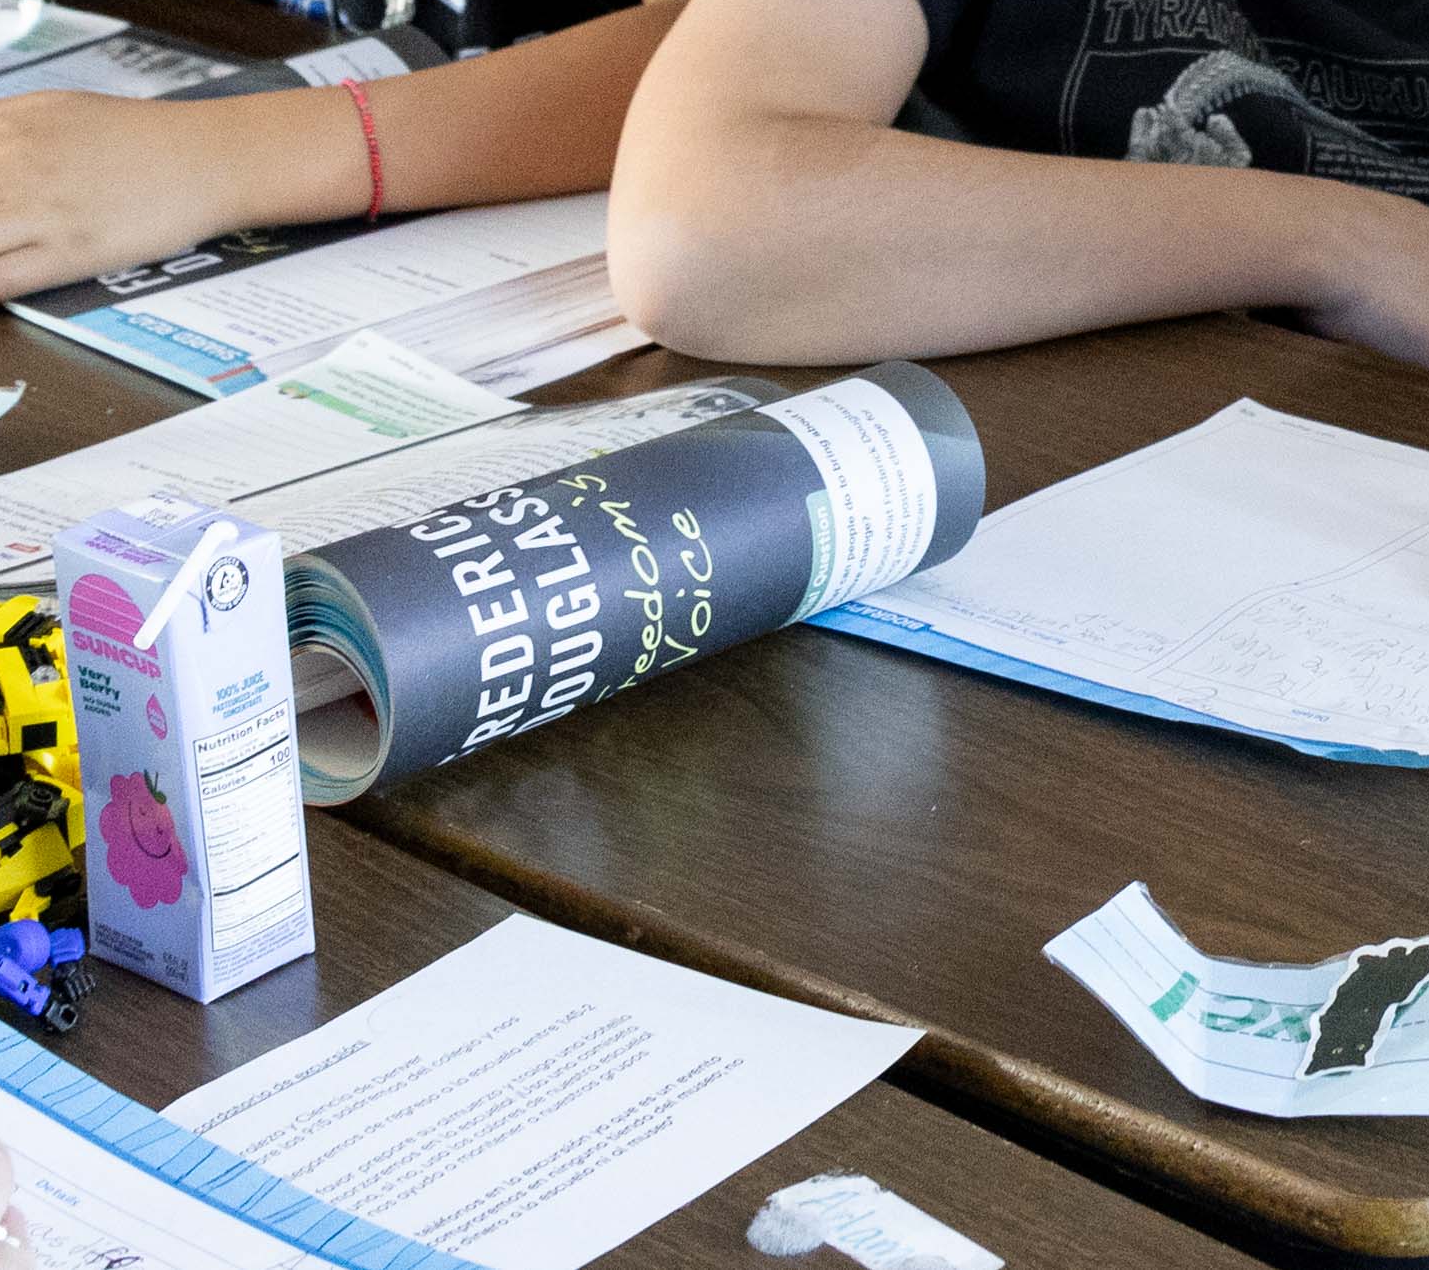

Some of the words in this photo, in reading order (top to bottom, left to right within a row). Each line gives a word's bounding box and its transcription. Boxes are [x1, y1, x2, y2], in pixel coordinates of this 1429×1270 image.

[793, 412, 821, 438] about
[873, 422, 900, 476] change
[818, 438, 842, 479] bring
[846, 515, 859, 561] people
[660, 507, 713, 669] Voice
[841, 602, 924, 631] BIOGRAPH
[72, 630, 161, 678] SUNCUP
[392, 510, 535, 766] REDERIC
[78, 665, 111, 686] Very
[79, 677, 120, 700] Berry
[216, 683, 240, 701] 100%
[242, 670, 264, 691] JUICE
[197, 725, 253, 754] Nutrition
[256, 708, 285, 728] Facts
[269, 746, 291, 765] 100
[202, 775, 246, 796] Calories
[275, 1133, 308, 1149] las
[328, 1079, 411, 1120] saldremos
[400, 1066, 433, 1081] del
[424, 1037, 487, 1068] colegio
[486, 1015, 524, 1033] nos
[278, 1133, 372, 1181] legaremos
[357, 1120, 387, 1134] de
[381, 1092, 445, 1124] regreso
[461, 1045, 526, 1078] escuela
[516, 1024, 563, 1047] entre
[290, 1091, 355, 1124] Ciencia
[347, 1082, 375, 1094] de
[367, 1054, 430, 1084] Denver
[311, 1170, 360, 1196] favor
[350, 1136, 422, 1173] prepare
[413, 1125, 439, 1137] su
[431, 1087, 507, 1126] almuerzo
[508, 1057, 562, 1084] traiga
[550, 1039, 589, 1058] una
[578, 1012, 635, 1041] botella
[323, 1150, 426, 1204] morzaremos
[416, 1138, 443, 1151] en
[541, 1060, 581, 1079] una
[570, 1024, 644, 1061] camiseta
[360, 1197, 399, 1217] nos
[390, 1169, 451, 1201] ayuda
[450, 1122, 529, 1164] mantener
[531, 1079, 604, 1117] nuestros
[592, 1049, 657, 1081] grupos
[415, 1148, 454, 1168] usa
[444, 1135, 475, 1150] los
[466, 1106, 529, 1139] colores
[518, 1094, 548, 1108] de
[537, 1062, 603, 1096] nuestra
[409, 1196, 487, 1239] teléfonos
[479, 1184, 507, 1198] en
[514, 1132, 595, 1176] excursión
[586, 1122, 614, 1136] ya
[604, 1105, 643, 1124] que
[633, 1094, 659, 1107] es
[650, 1082, 679, 1096] un
[668, 1054, 726, 1084] evento
[422, 1188, 532, 1249] compraremos
[522, 1176, 549, 1190] en
[541, 1139, 614, 1179] ninguna
[602, 1112, 656, 1141] tienda
[647, 1098, 679, 1114] del
[719, 1057, 748, 1070] no
[456, 1216, 512, 1247] dinero
[531, 1165, 598, 1202] escuela
